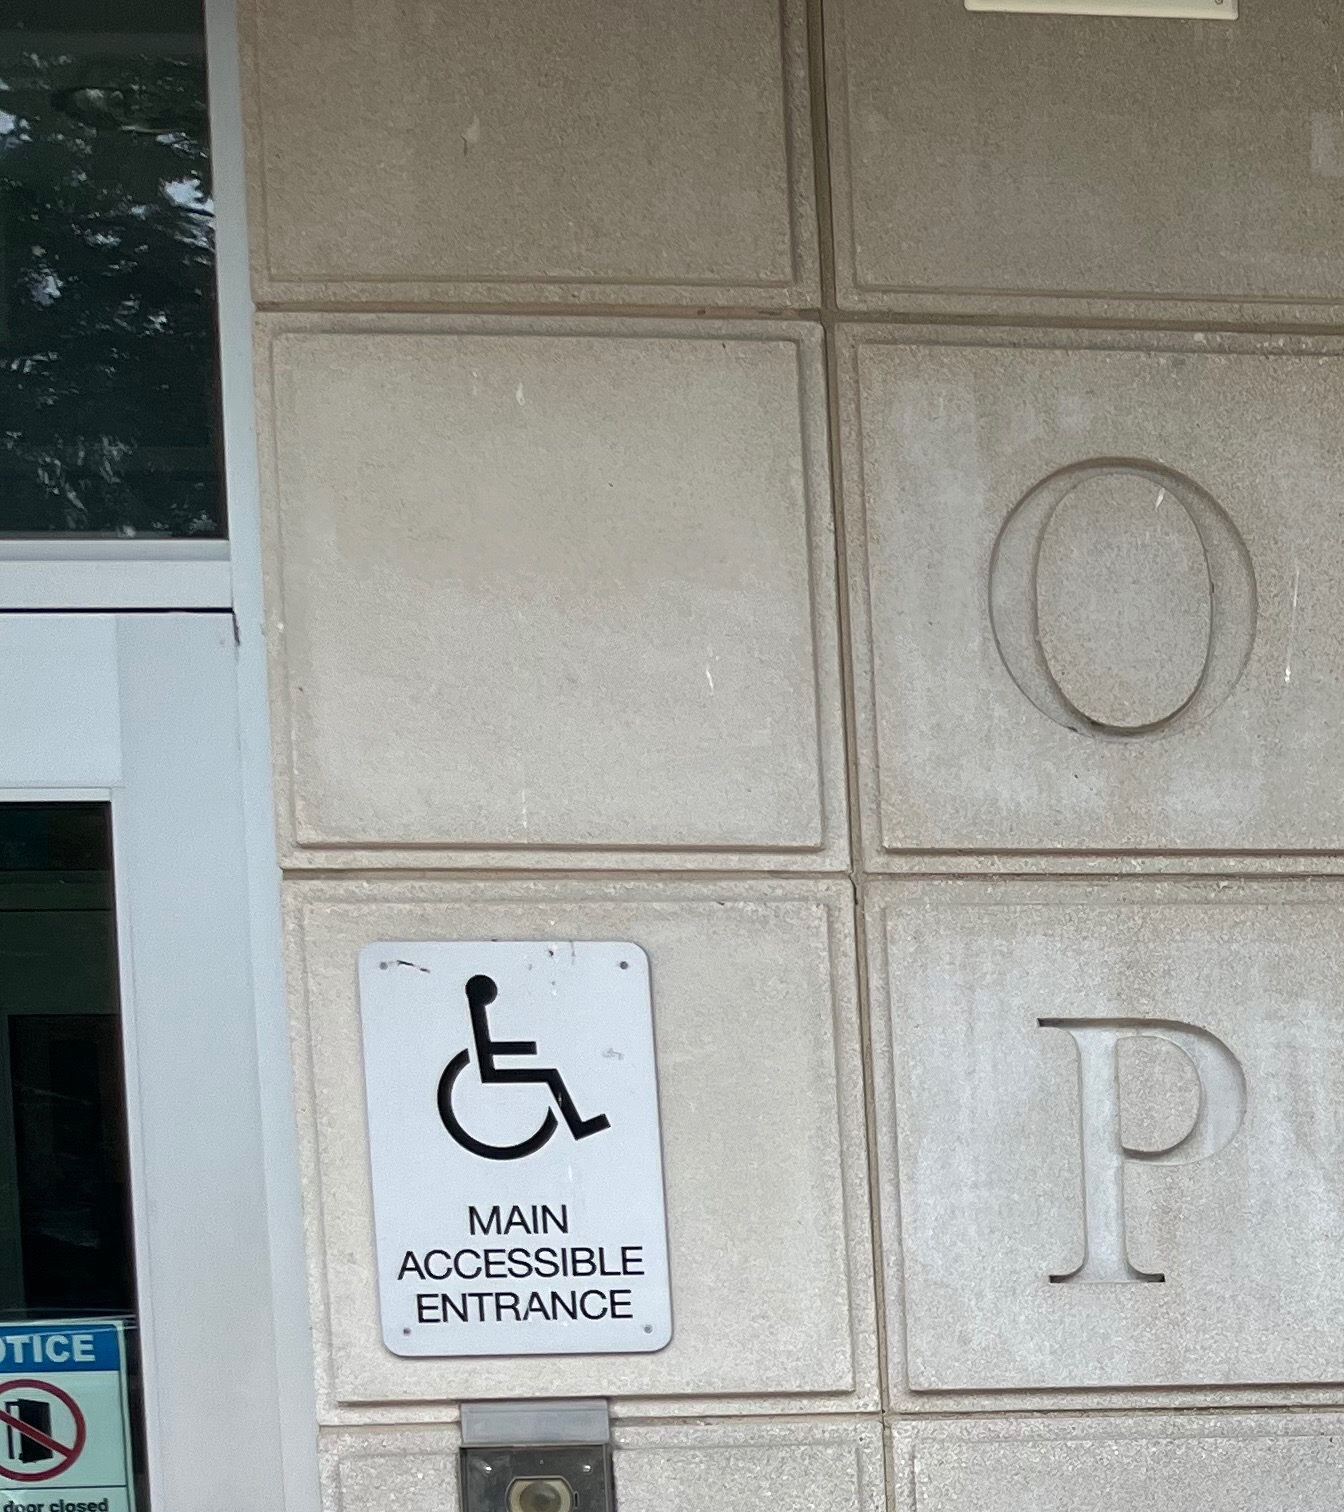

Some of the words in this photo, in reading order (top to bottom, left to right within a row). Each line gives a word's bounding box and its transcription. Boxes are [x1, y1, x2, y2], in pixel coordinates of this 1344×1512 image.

[468, 1204, 569, 1236] MAIN
[397, 1246, 646, 1281] ACCESSIBLE
[416, 1289, 634, 1324] ENTRANCE
[0, 1334, 96, 1364] TICE
